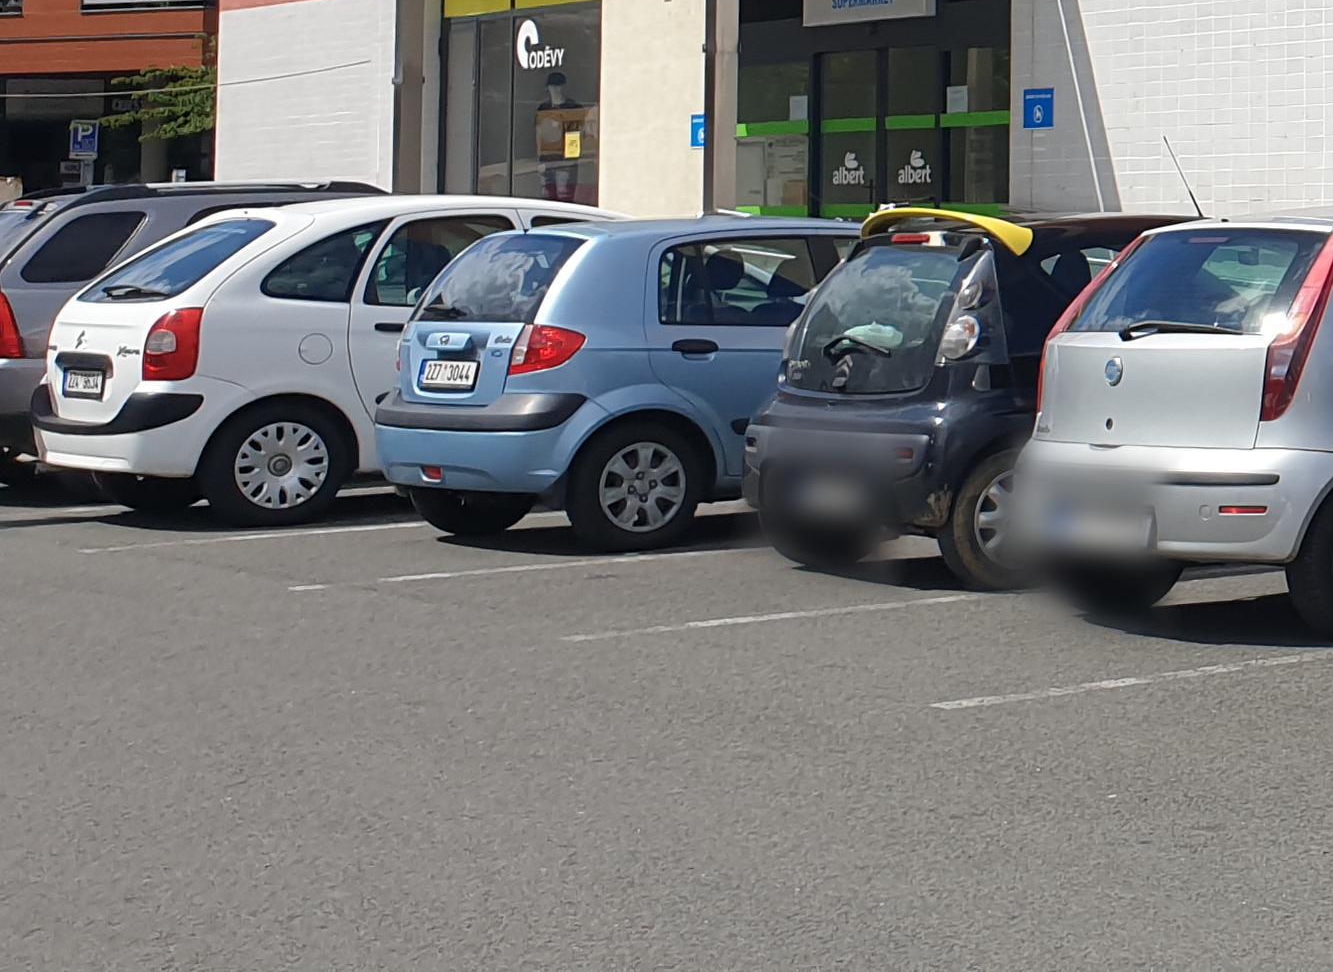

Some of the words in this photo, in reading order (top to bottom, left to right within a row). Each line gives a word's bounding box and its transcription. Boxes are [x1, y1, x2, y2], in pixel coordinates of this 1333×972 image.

[77, 124, 93, 142] P
[832, 166, 865, 185] albert
[898, 164, 931, 184] albert
[446, 364, 471, 382] 3044
